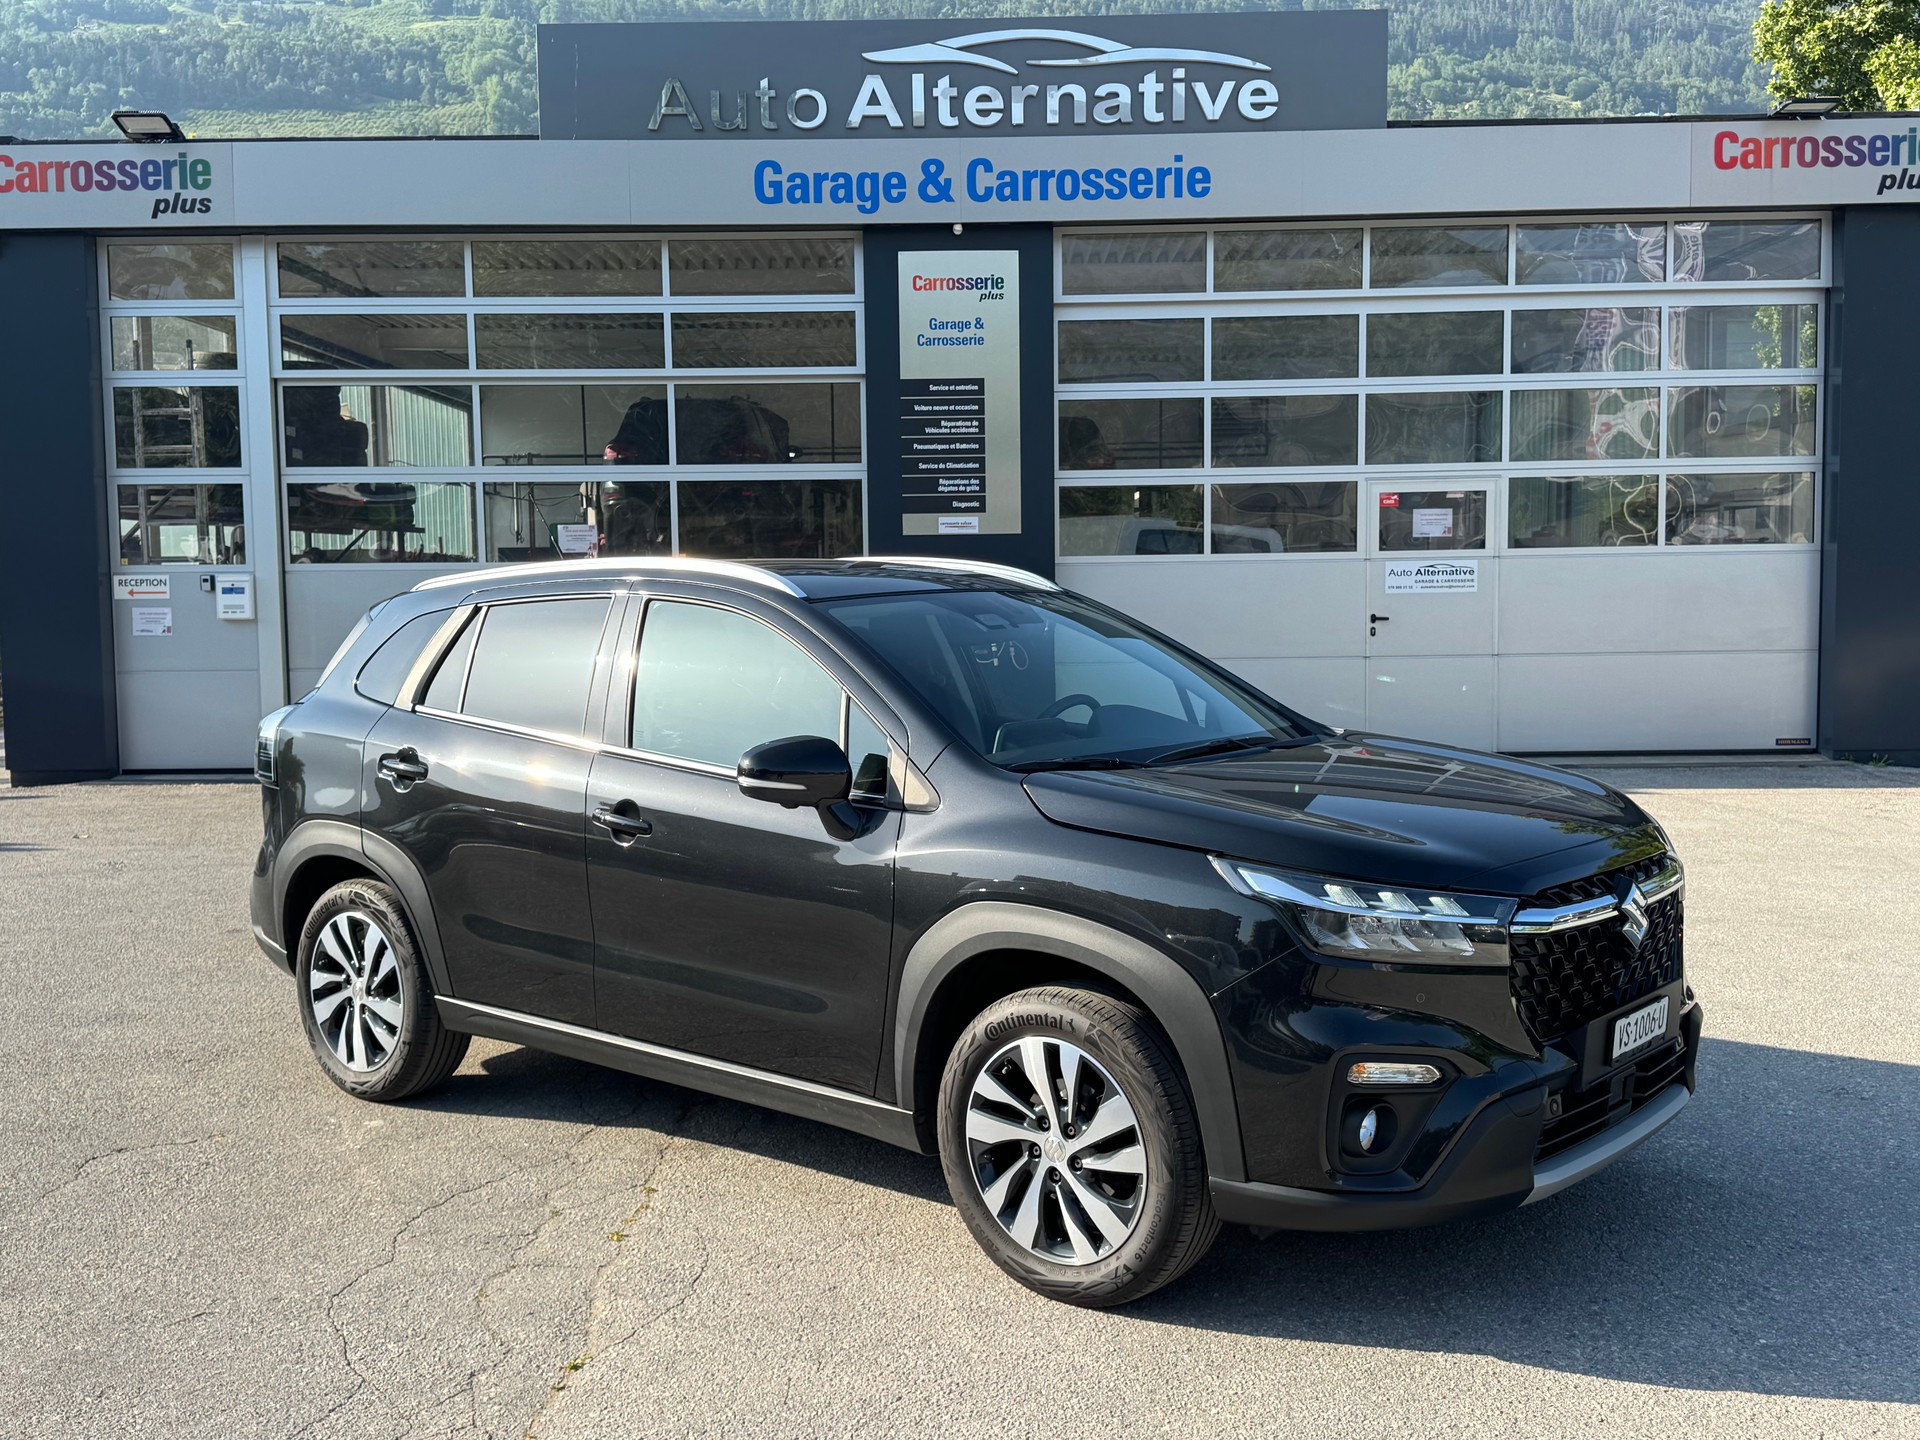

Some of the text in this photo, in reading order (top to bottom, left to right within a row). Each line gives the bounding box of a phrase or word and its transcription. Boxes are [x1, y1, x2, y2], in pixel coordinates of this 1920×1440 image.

[648, 68, 1279, 130] Auto Alternative
[1713, 127, 1920, 170] Carrosseri
[0, 152, 212, 193] Carrosserie
[754, 155, 1211, 214] Garage & Carrosserie
[1876, 168, 1920, 195] plu
[151, 192, 212, 219] plus
[912, 274, 1005, 291] Carrosserie
[979, 291, 1005, 302] plus
[929, 317, 985, 333] Garage &
[917, 333, 985, 346] Carrosserie
[939, 478, 969, 486] Réparations
[118, 578, 167, 587] RECEPTION
[1388, 567, 1475, 577] Auto Alternative
[984, 1014, 1063, 1041] Continental
[1134, 1192, 1166, 1263] EcoContact 6
